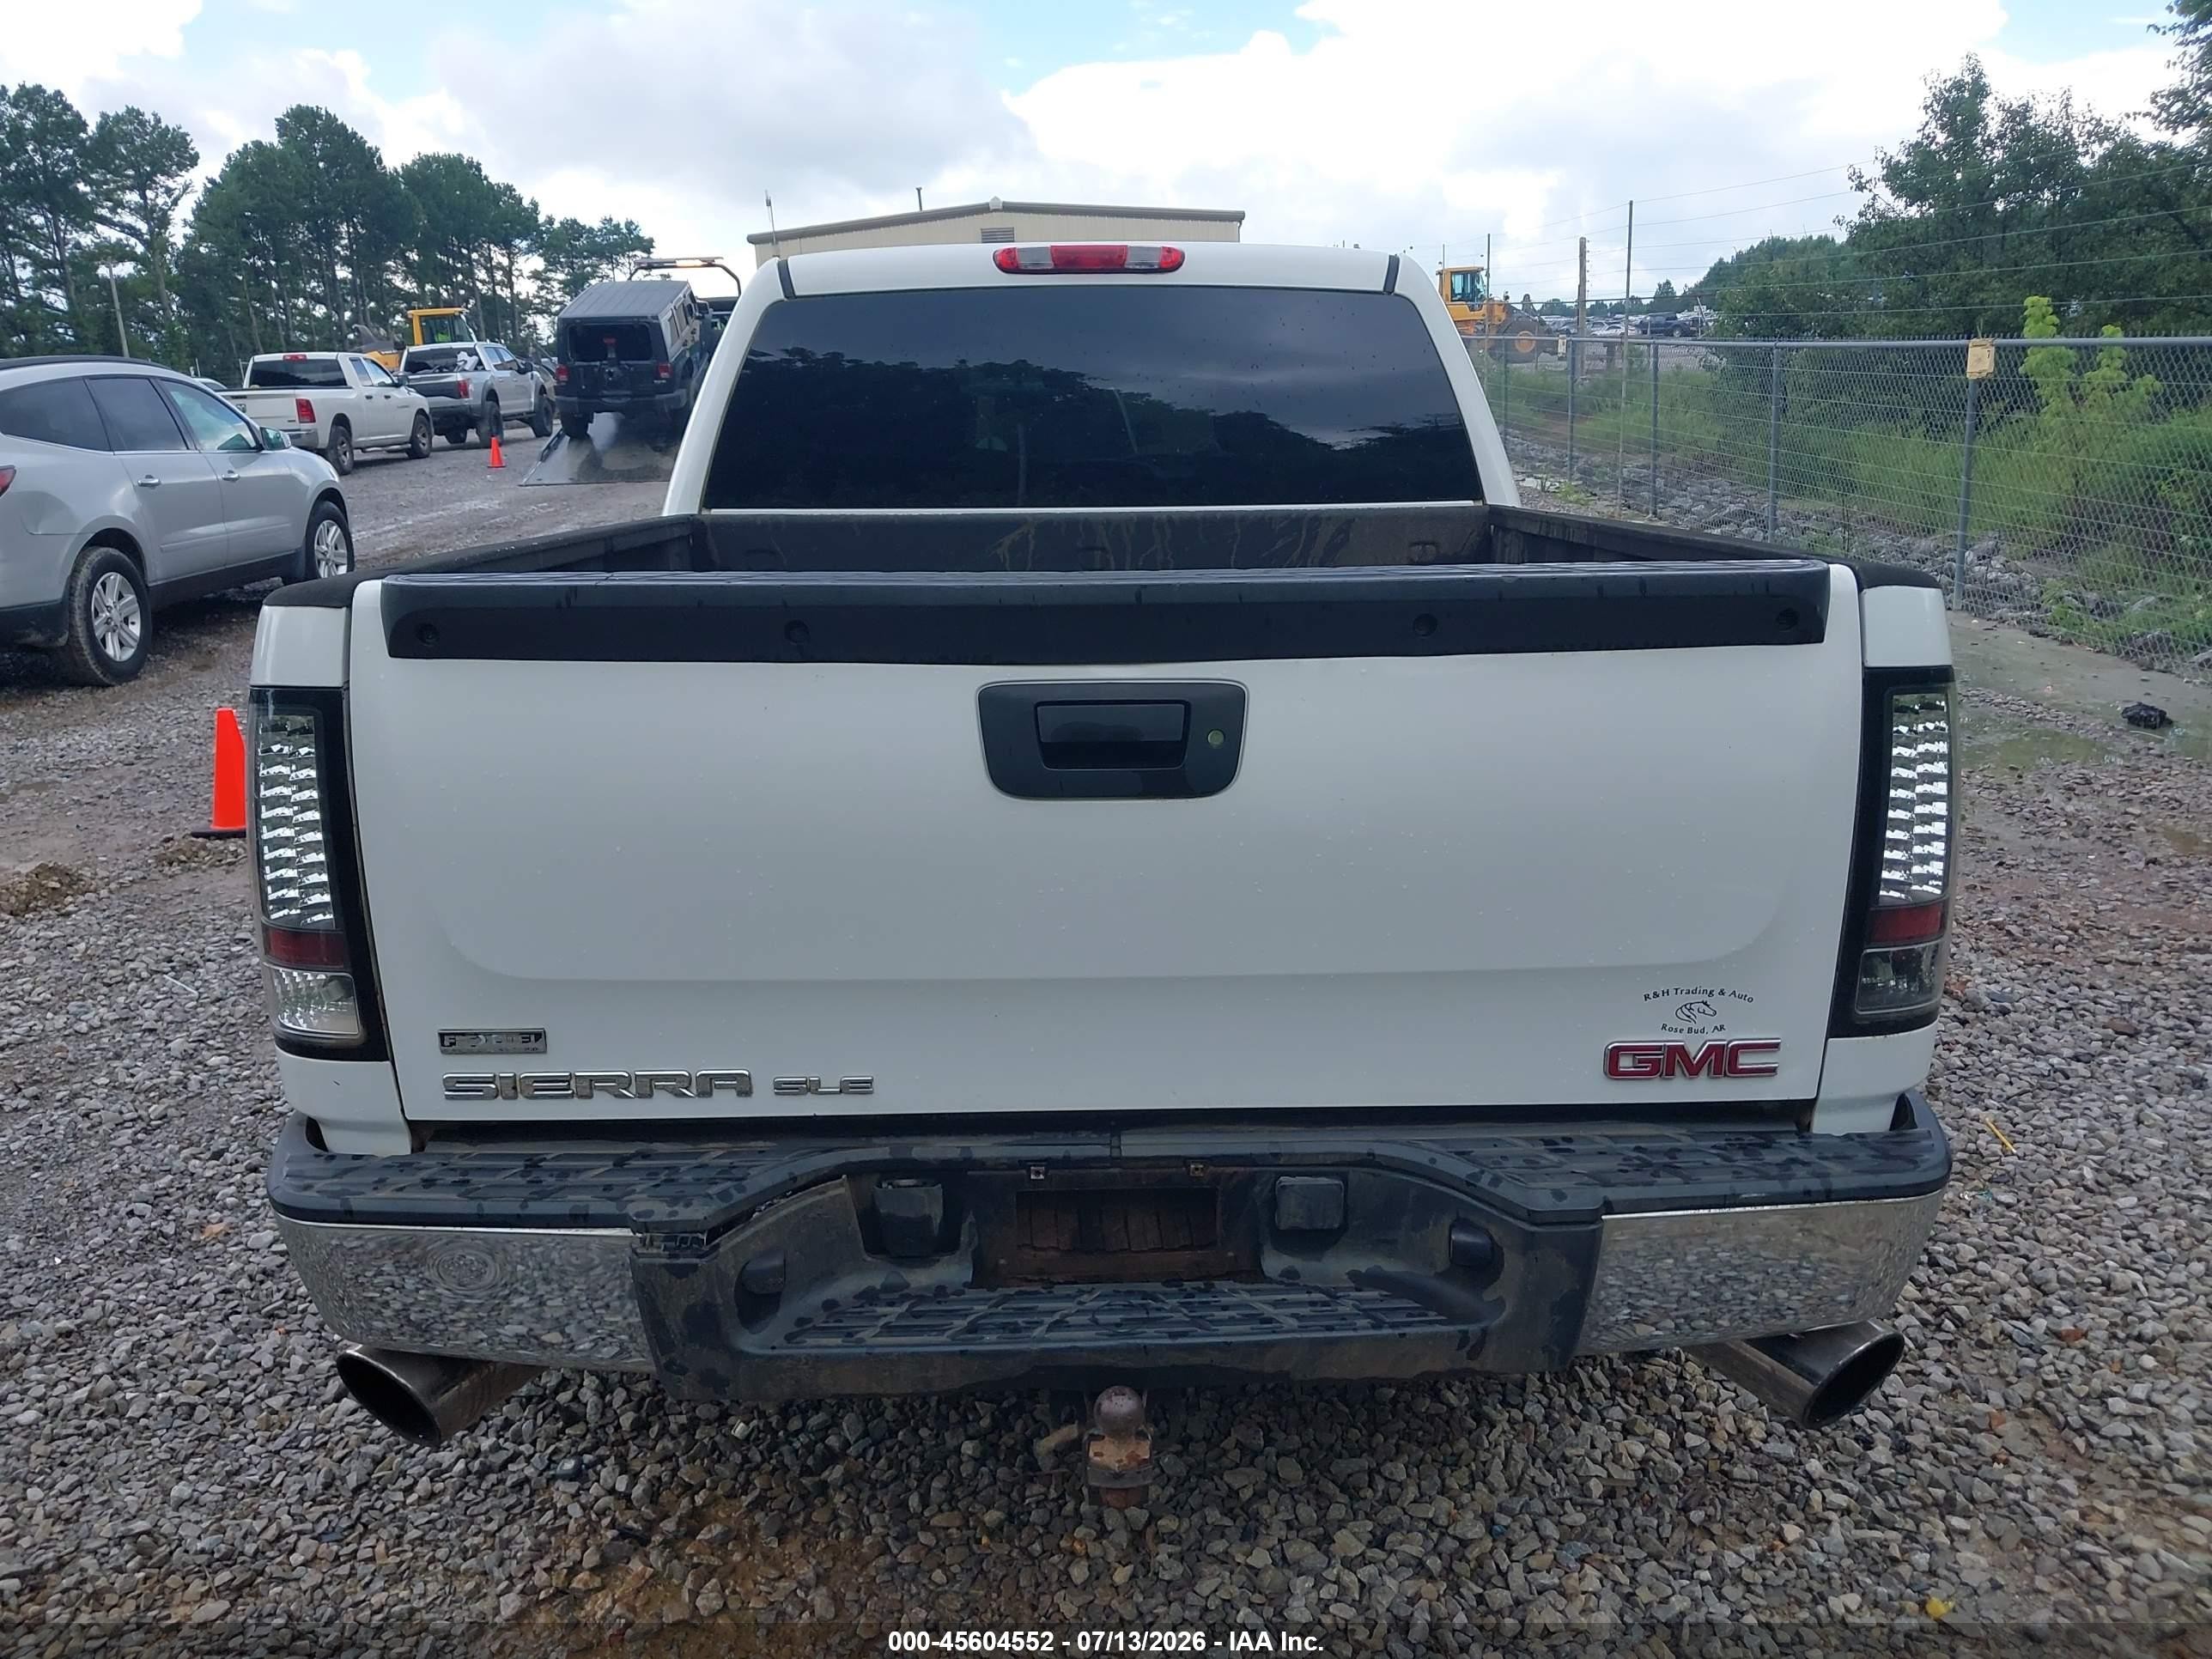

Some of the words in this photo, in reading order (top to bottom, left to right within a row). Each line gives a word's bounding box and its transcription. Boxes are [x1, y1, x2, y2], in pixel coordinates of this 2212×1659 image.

[1644, 988, 1670, 1002] R&H
[1673, 986, 1715, 998] Trading
[1717, 988, 1727, 997] &
[1729, 989, 1754, 1004] Auto
[1661, 1023, 1685, 1035] Rose
[1686, 1026, 1709, 1036] Bud,
[1711, 1024, 1726, 1034] AR
[1604, 1037, 1782, 1079] GMC
[442, 1068, 753, 1101] SIERRA
[773, 1075, 874, 1096] SLE
